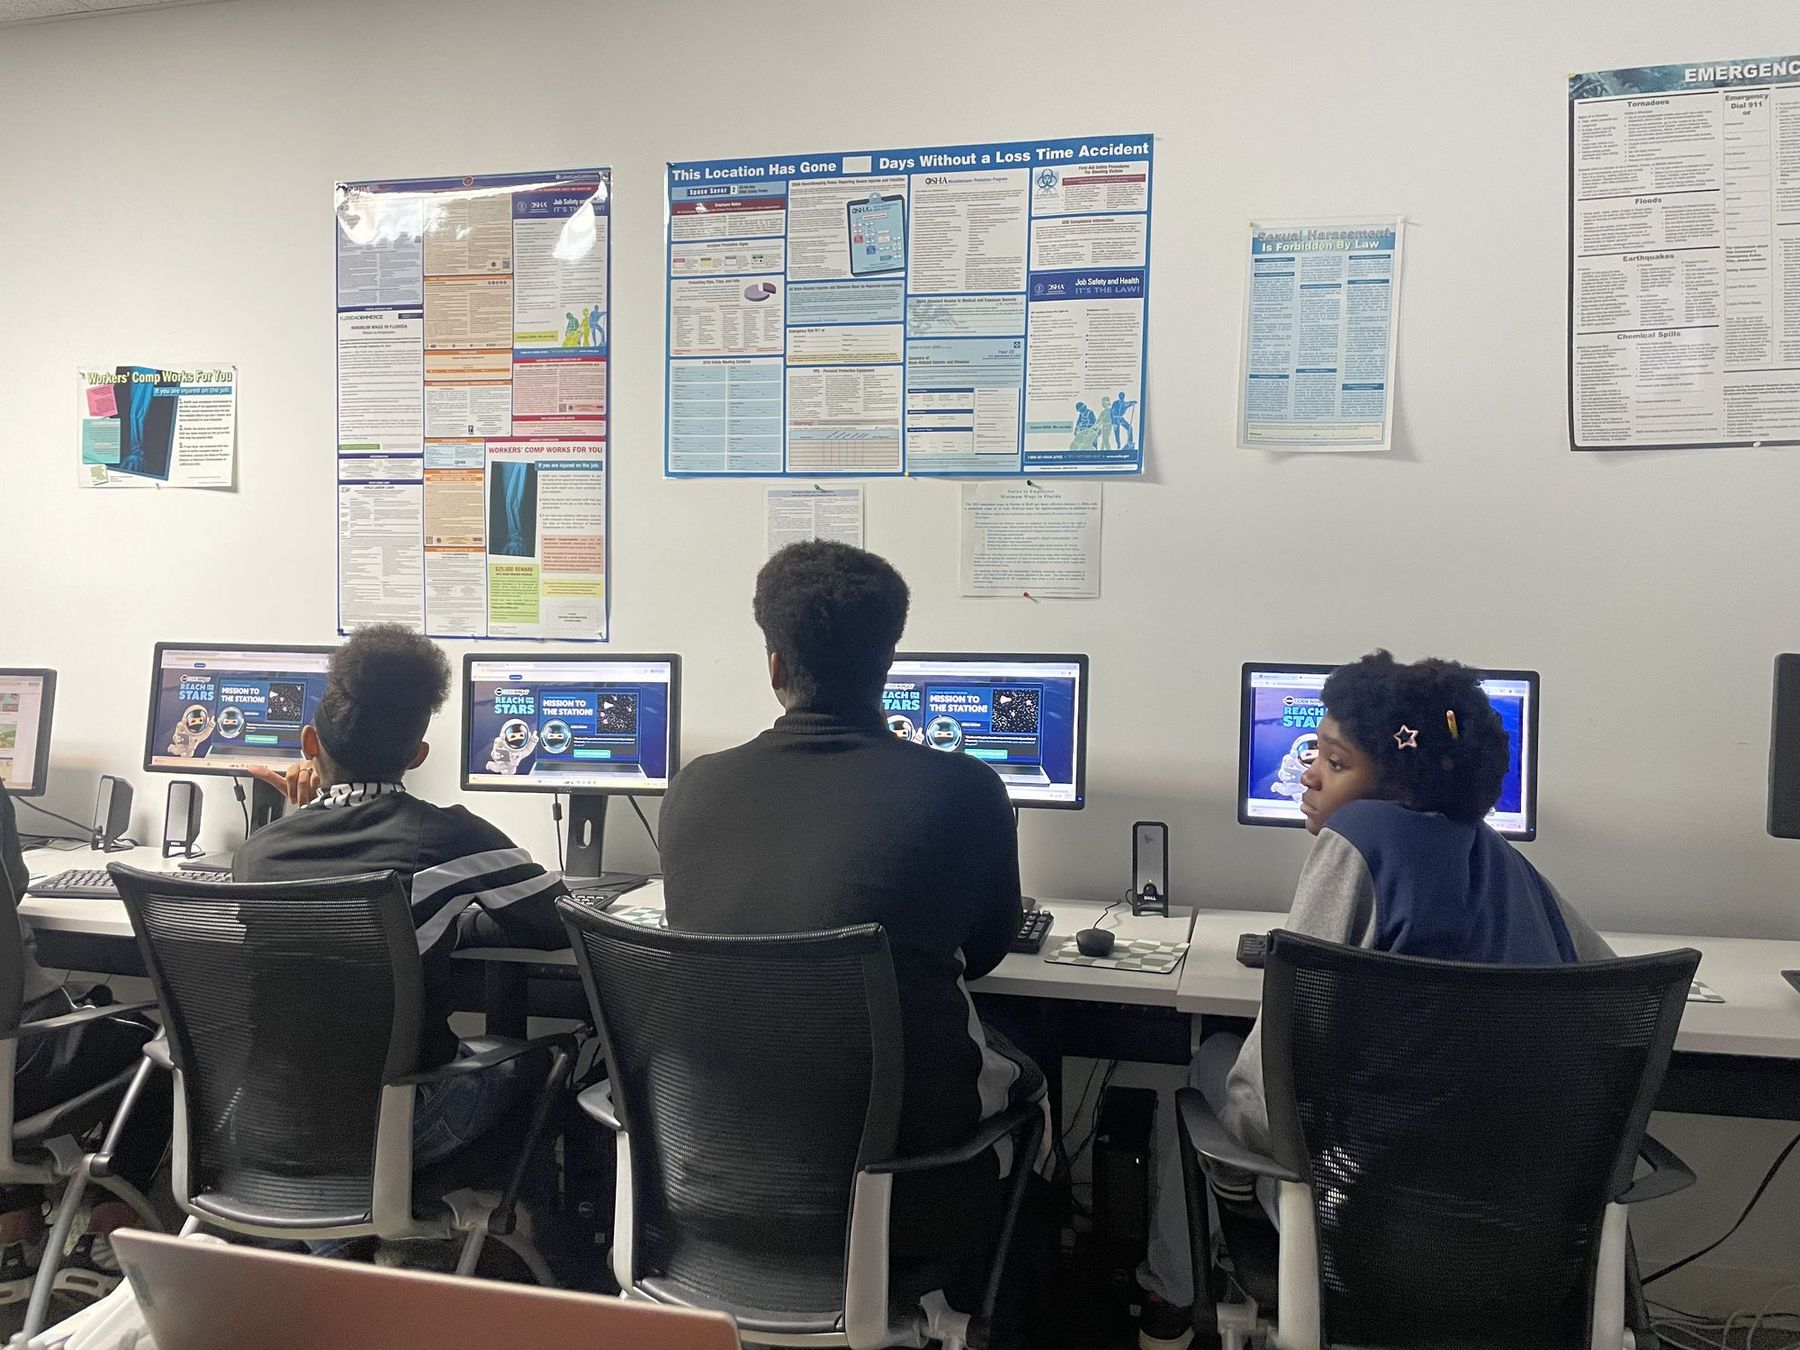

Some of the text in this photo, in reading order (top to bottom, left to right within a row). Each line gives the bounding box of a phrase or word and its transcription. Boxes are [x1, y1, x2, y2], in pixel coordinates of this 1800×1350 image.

[1684, 60, 1800, 82] EMERGENC
[672, 142, 1150, 180] This Location Has Gone Days Without a Loss Time Accident
[1258, 228, 1390, 241] Sexual Harassment
[1262, 240, 1380, 252] Is Forbidden By Law
[1623, 254, 1674, 262] Earthquakes
[1088, 278, 1106, 286] Safety
[88, 370, 232, 384] Workers' Comp Works For You
[179, 691, 214, 700] STARS
[495, 704, 534, 714] STARS
[883, 699, 920, 710] TARS
[1285, 707, 1324, 715] REACH
[1283, 716, 1323, 728] STA
